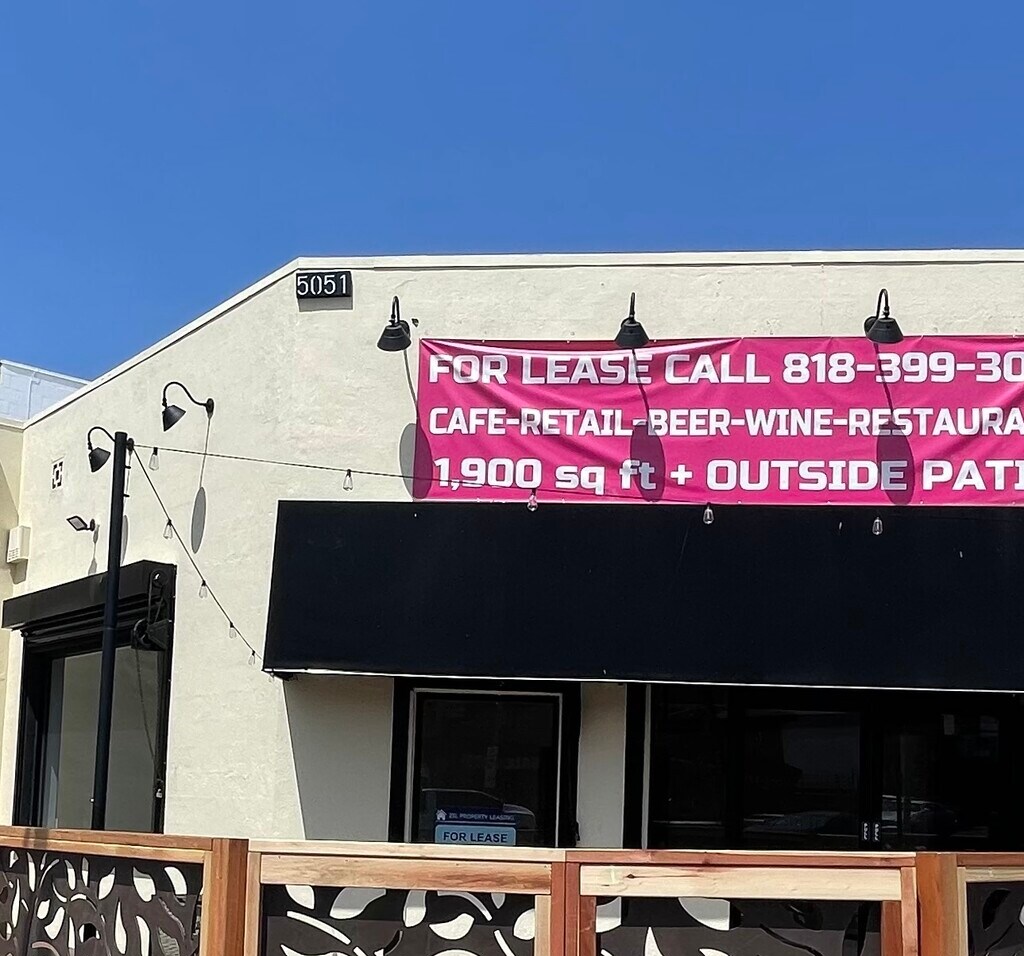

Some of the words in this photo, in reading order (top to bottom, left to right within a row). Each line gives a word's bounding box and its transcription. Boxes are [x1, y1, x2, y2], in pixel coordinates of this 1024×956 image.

[296, 274, 347, 296] 5051
[428, 354, 508, 384] FOR
[520, 353, 652, 385] LEASE
[665, 352, 770, 384] CALL
[433, 456, 541, 490] 1,900
[555, 464, 605, 497] sq
[619, 458, 657, 490] ft
[670, 463, 693, 487] +
[706, 457, 909, 491] OUTSIDE
[443, 832, 467, 842] FOR
[470, 832, 508, 843] LEASE
